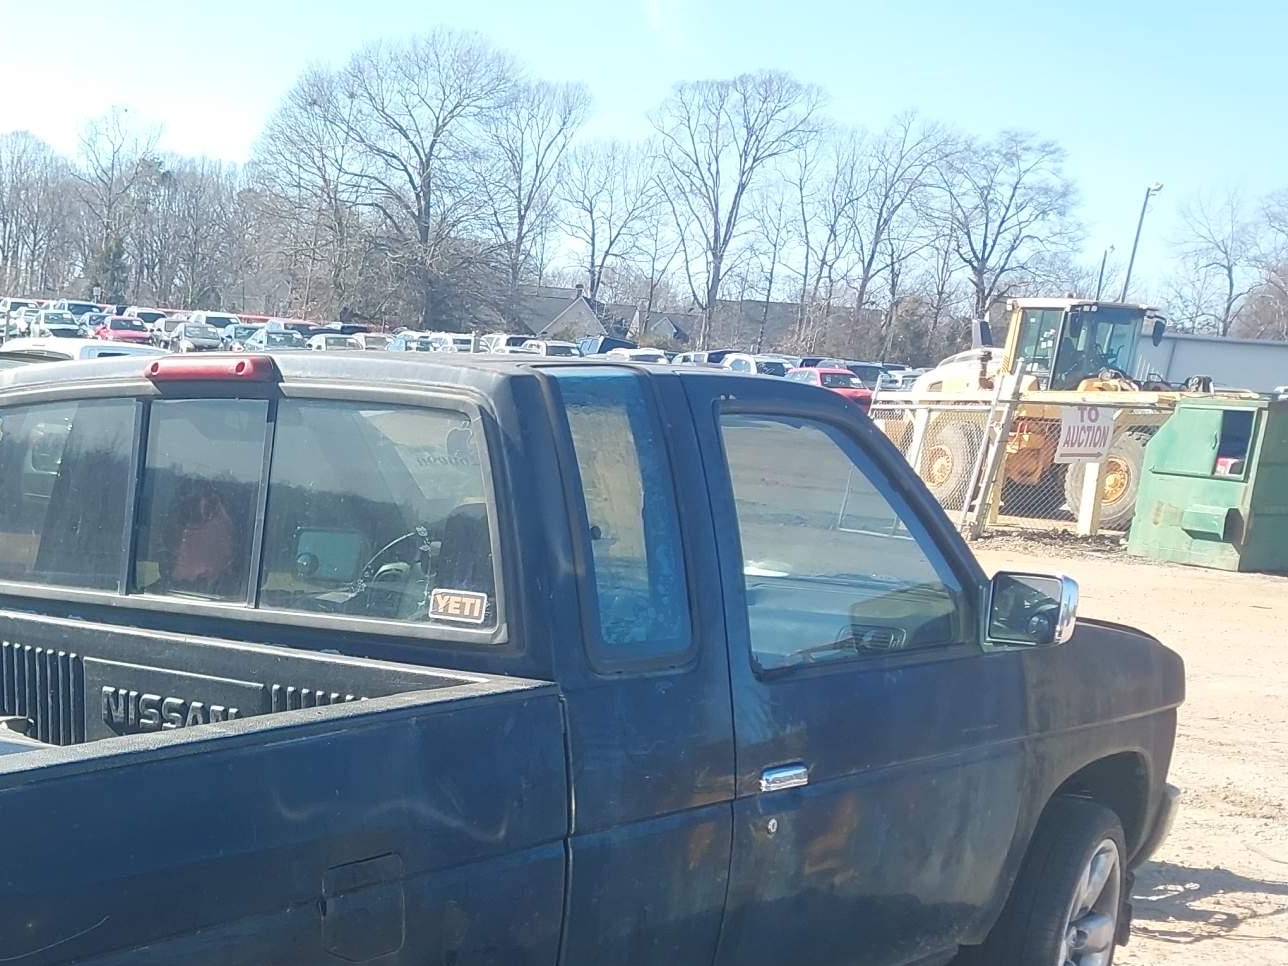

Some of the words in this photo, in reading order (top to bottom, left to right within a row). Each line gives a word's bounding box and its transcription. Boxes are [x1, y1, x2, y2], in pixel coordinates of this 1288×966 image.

[1078, 405, 1100, 423] TO
[1063, 425, 1110, 448] AUCTION
[435, 594, 482, 617] YETI
